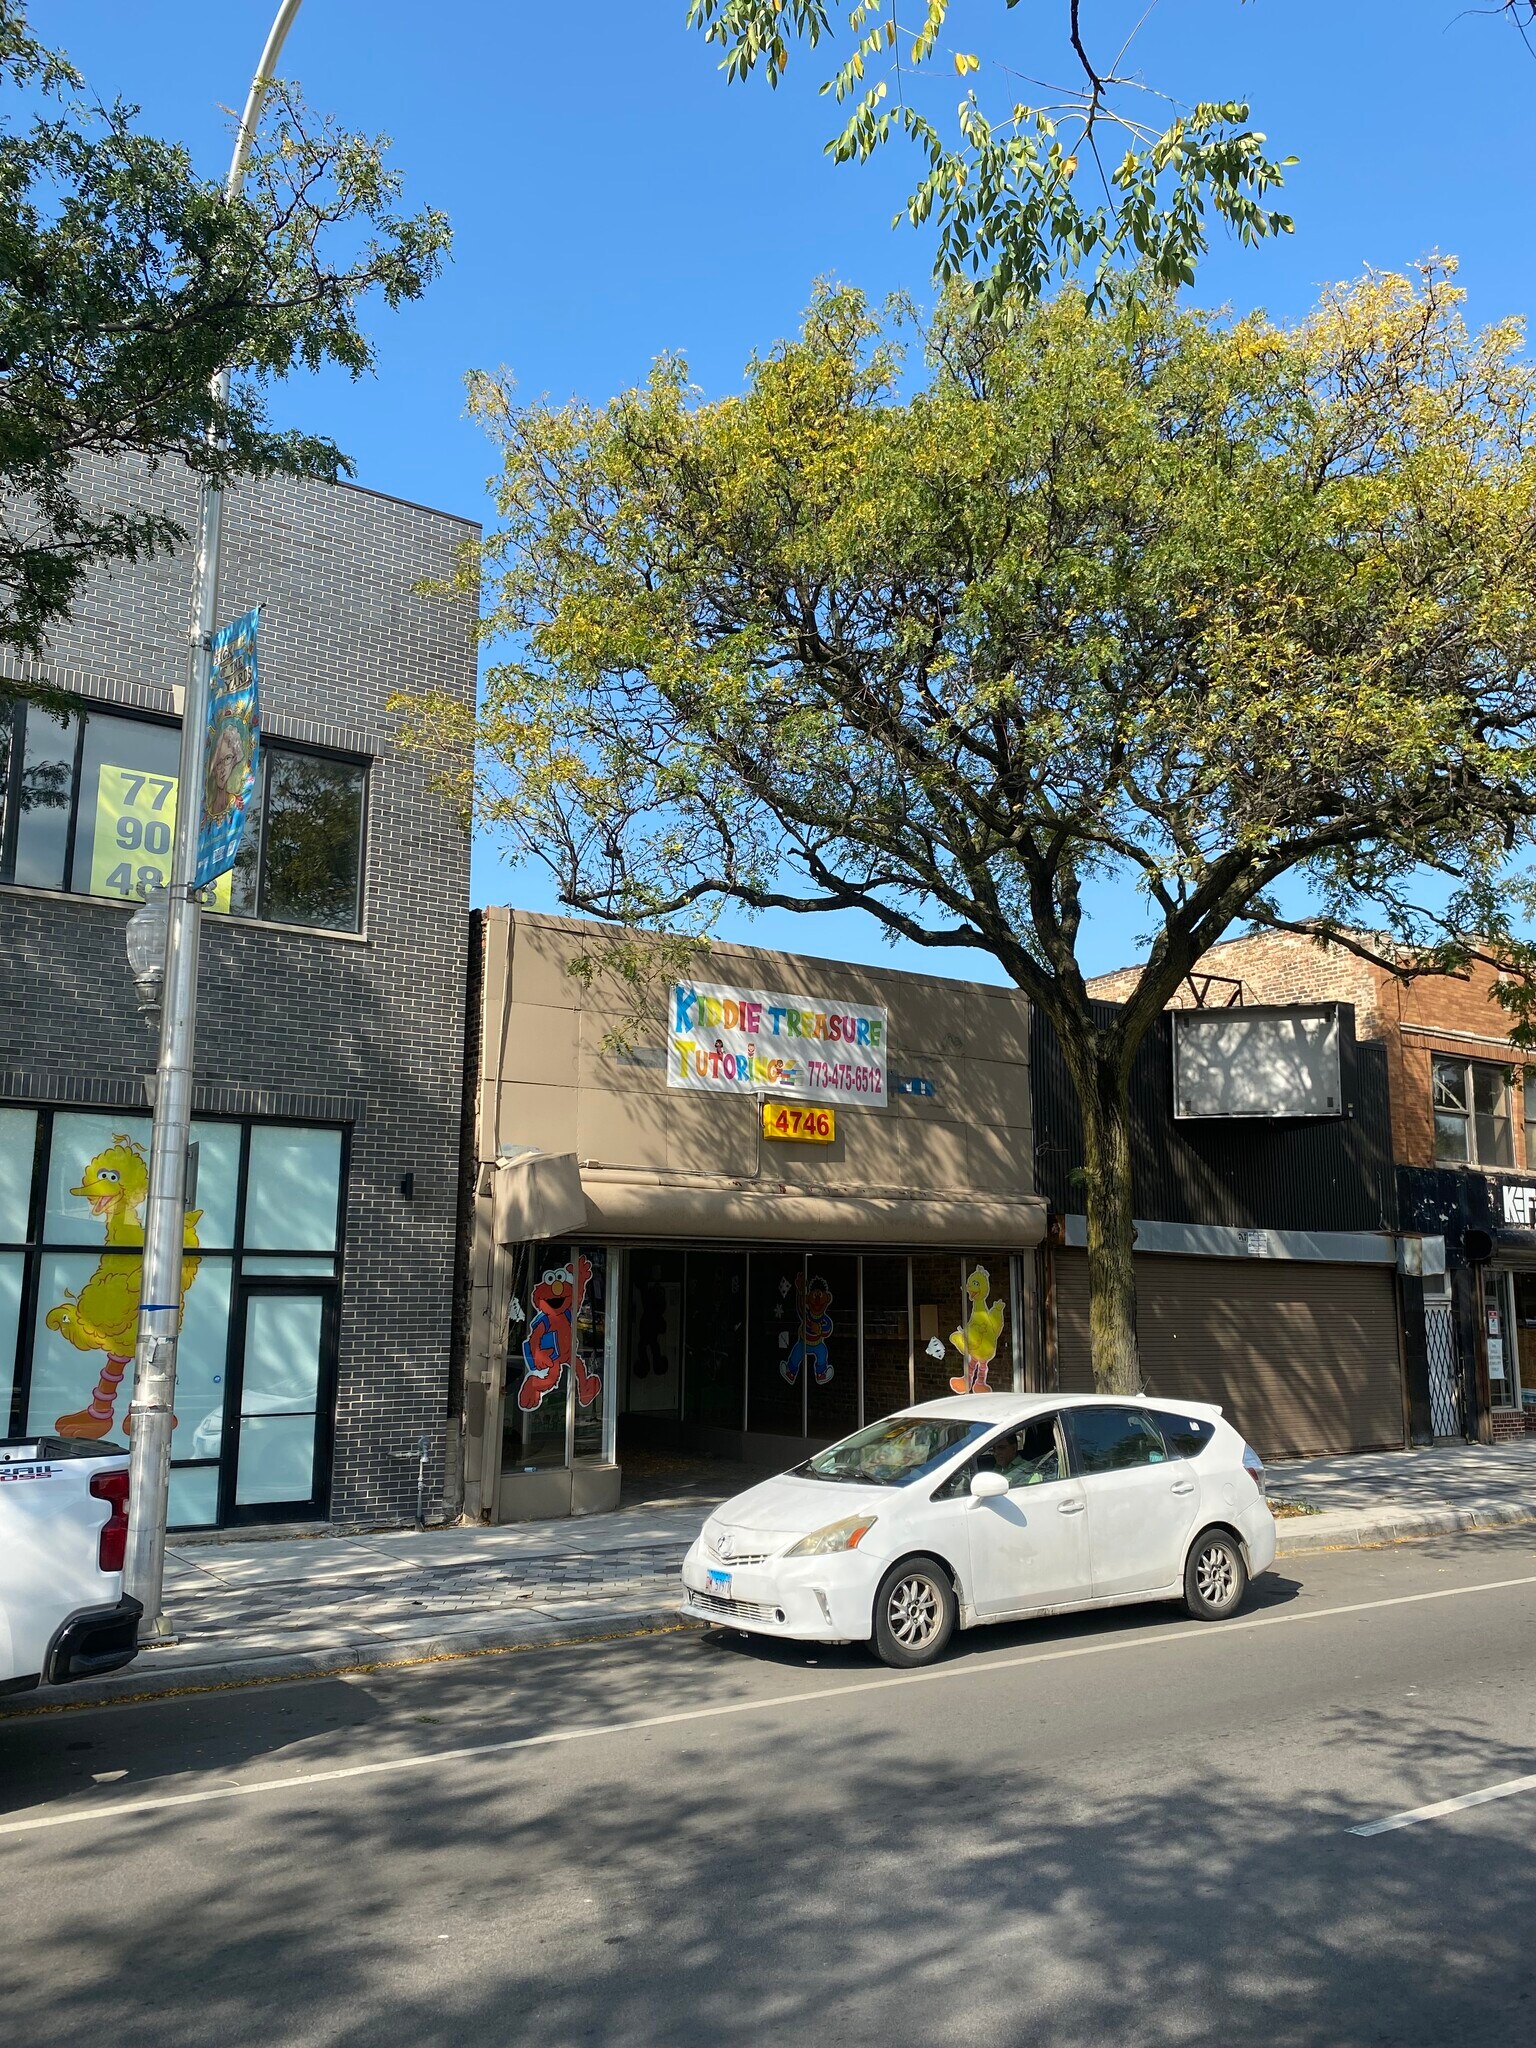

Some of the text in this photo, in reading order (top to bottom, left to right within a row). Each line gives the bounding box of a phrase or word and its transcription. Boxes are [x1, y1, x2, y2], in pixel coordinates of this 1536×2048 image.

[224, 666, 252, 691] YARDS
[120, 773, 174, 811] 77
[116, 816, 171, 854] 90
[675, 986, 882, 1047] KIDDIE TREASURE
[674, 1039, 779, 1083] TUTORING
[808, 1061, 882, 1094] 773-475-6512
[775, 1110, 830, 1136] 4746
[0, 1472, 52, 1481] OSS
